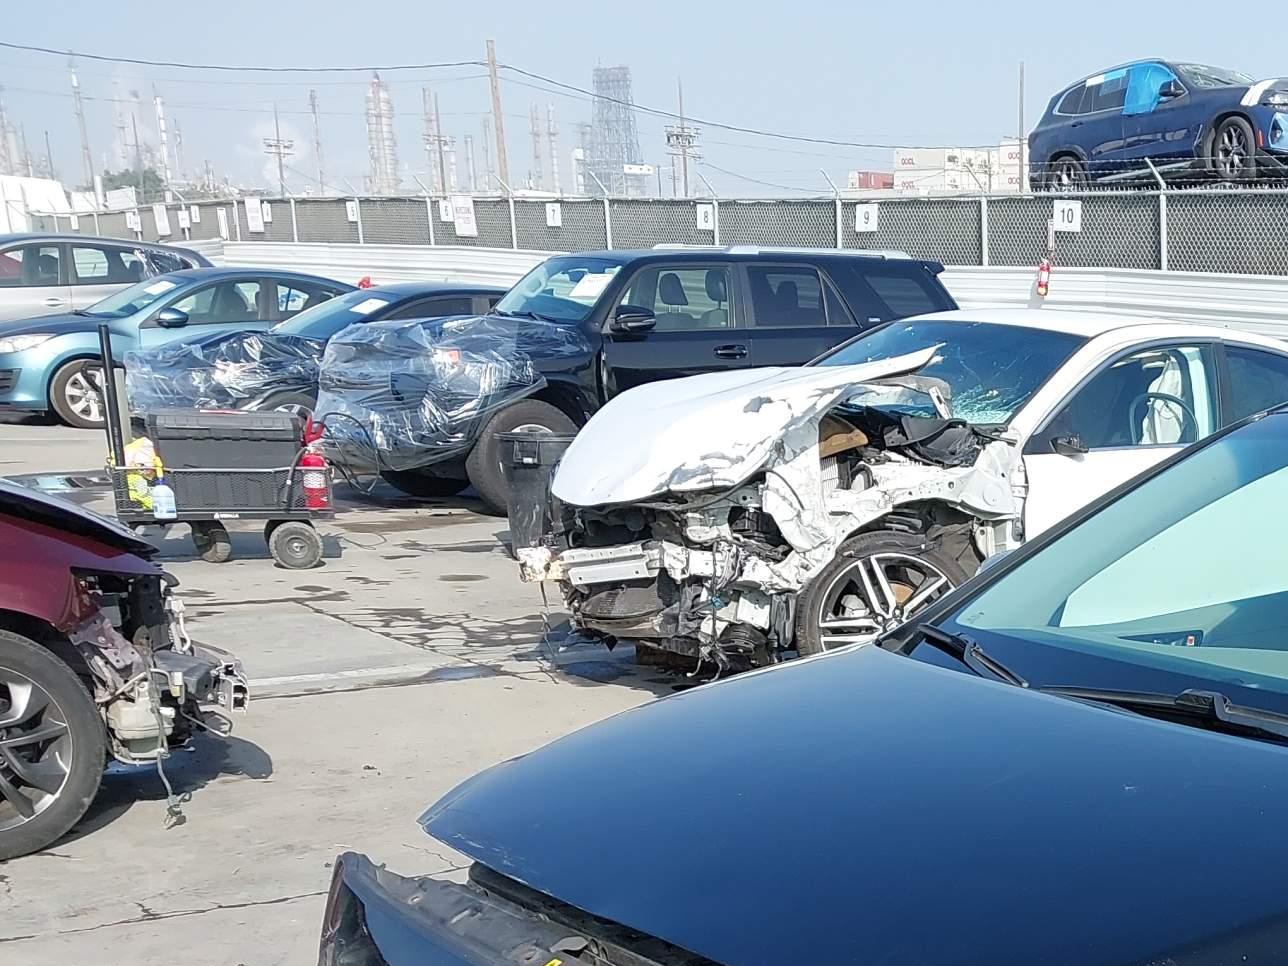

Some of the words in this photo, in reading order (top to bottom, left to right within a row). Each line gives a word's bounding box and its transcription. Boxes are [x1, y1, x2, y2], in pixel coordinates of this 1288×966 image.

[703, 210, 709, 223] 8
[863, 210, 870, 224] 9
[1060, 208, 1074, 224] 10
